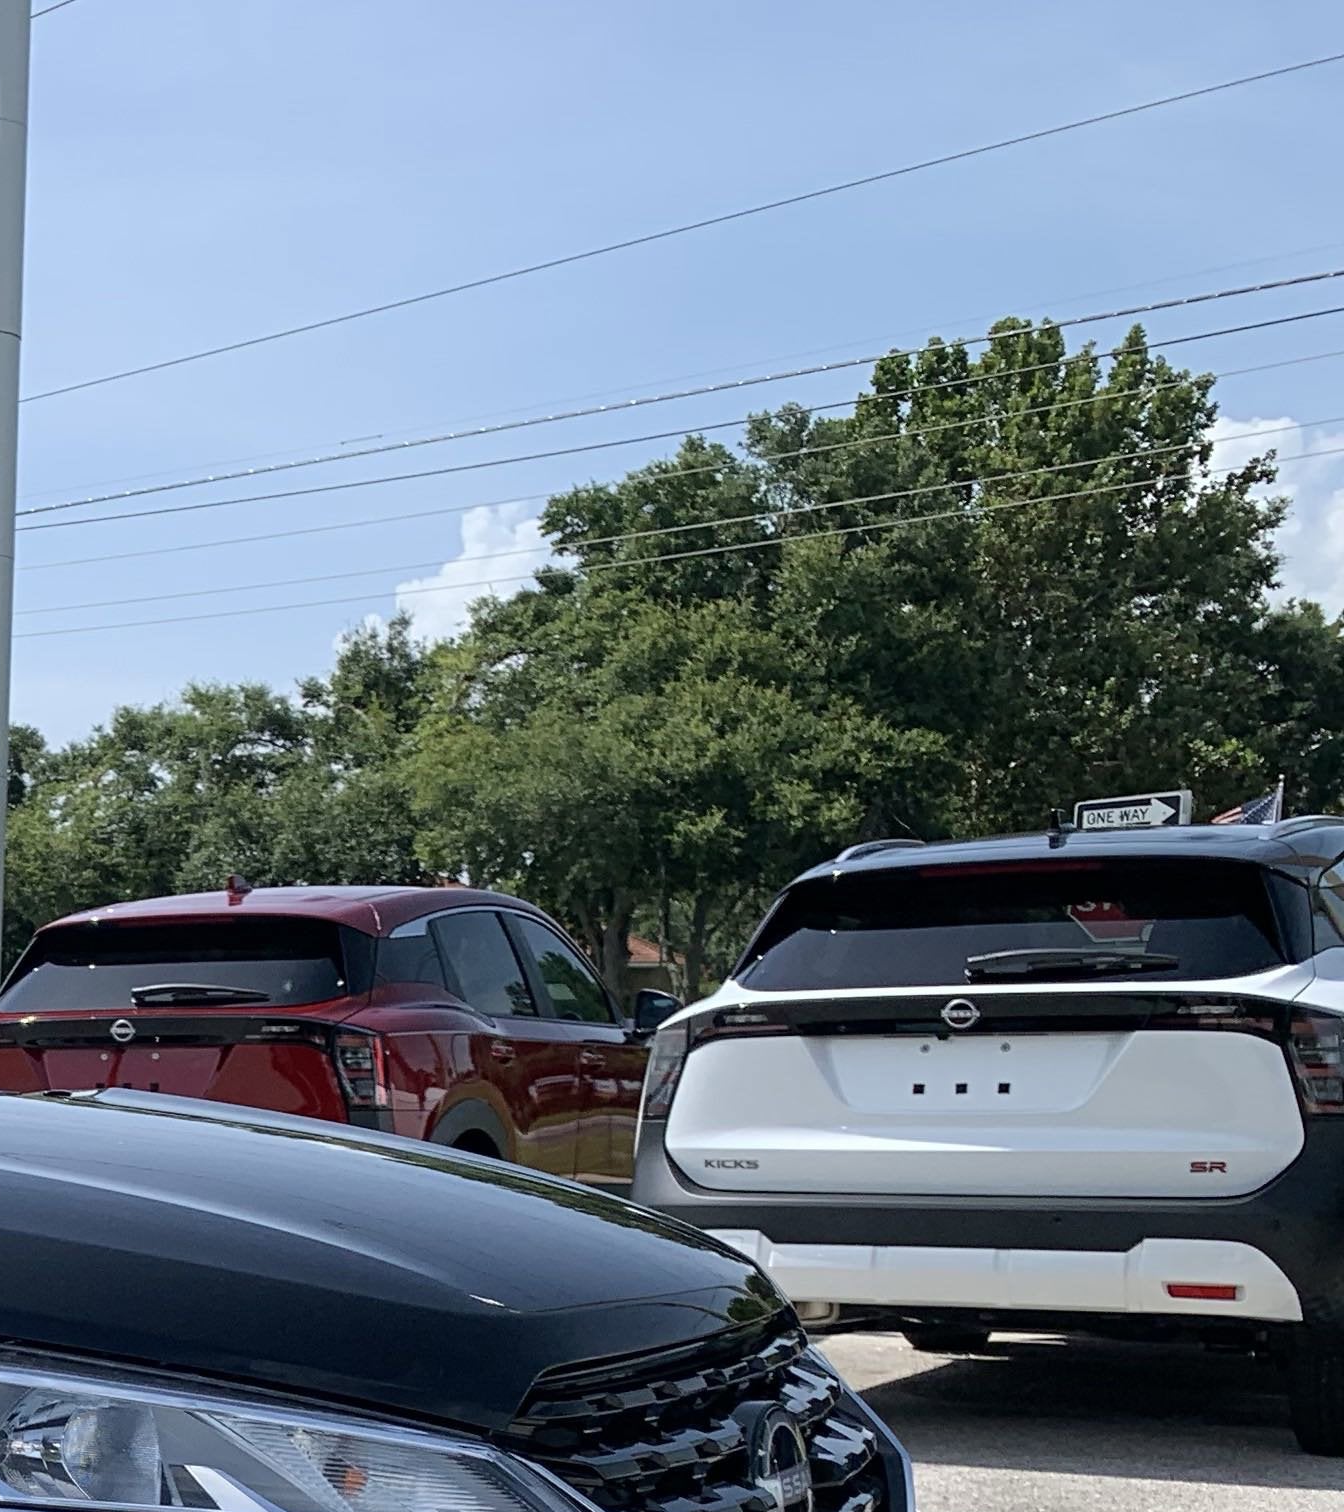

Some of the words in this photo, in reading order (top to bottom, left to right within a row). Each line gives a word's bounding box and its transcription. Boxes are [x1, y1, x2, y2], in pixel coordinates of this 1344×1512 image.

[1087, 810, 1115, 826] ONE
[1119, 807, 1149, 822] WAY
[704, 1159, 760, 1169] KICKS
[1190, 1161, 1227, 1173] SR
